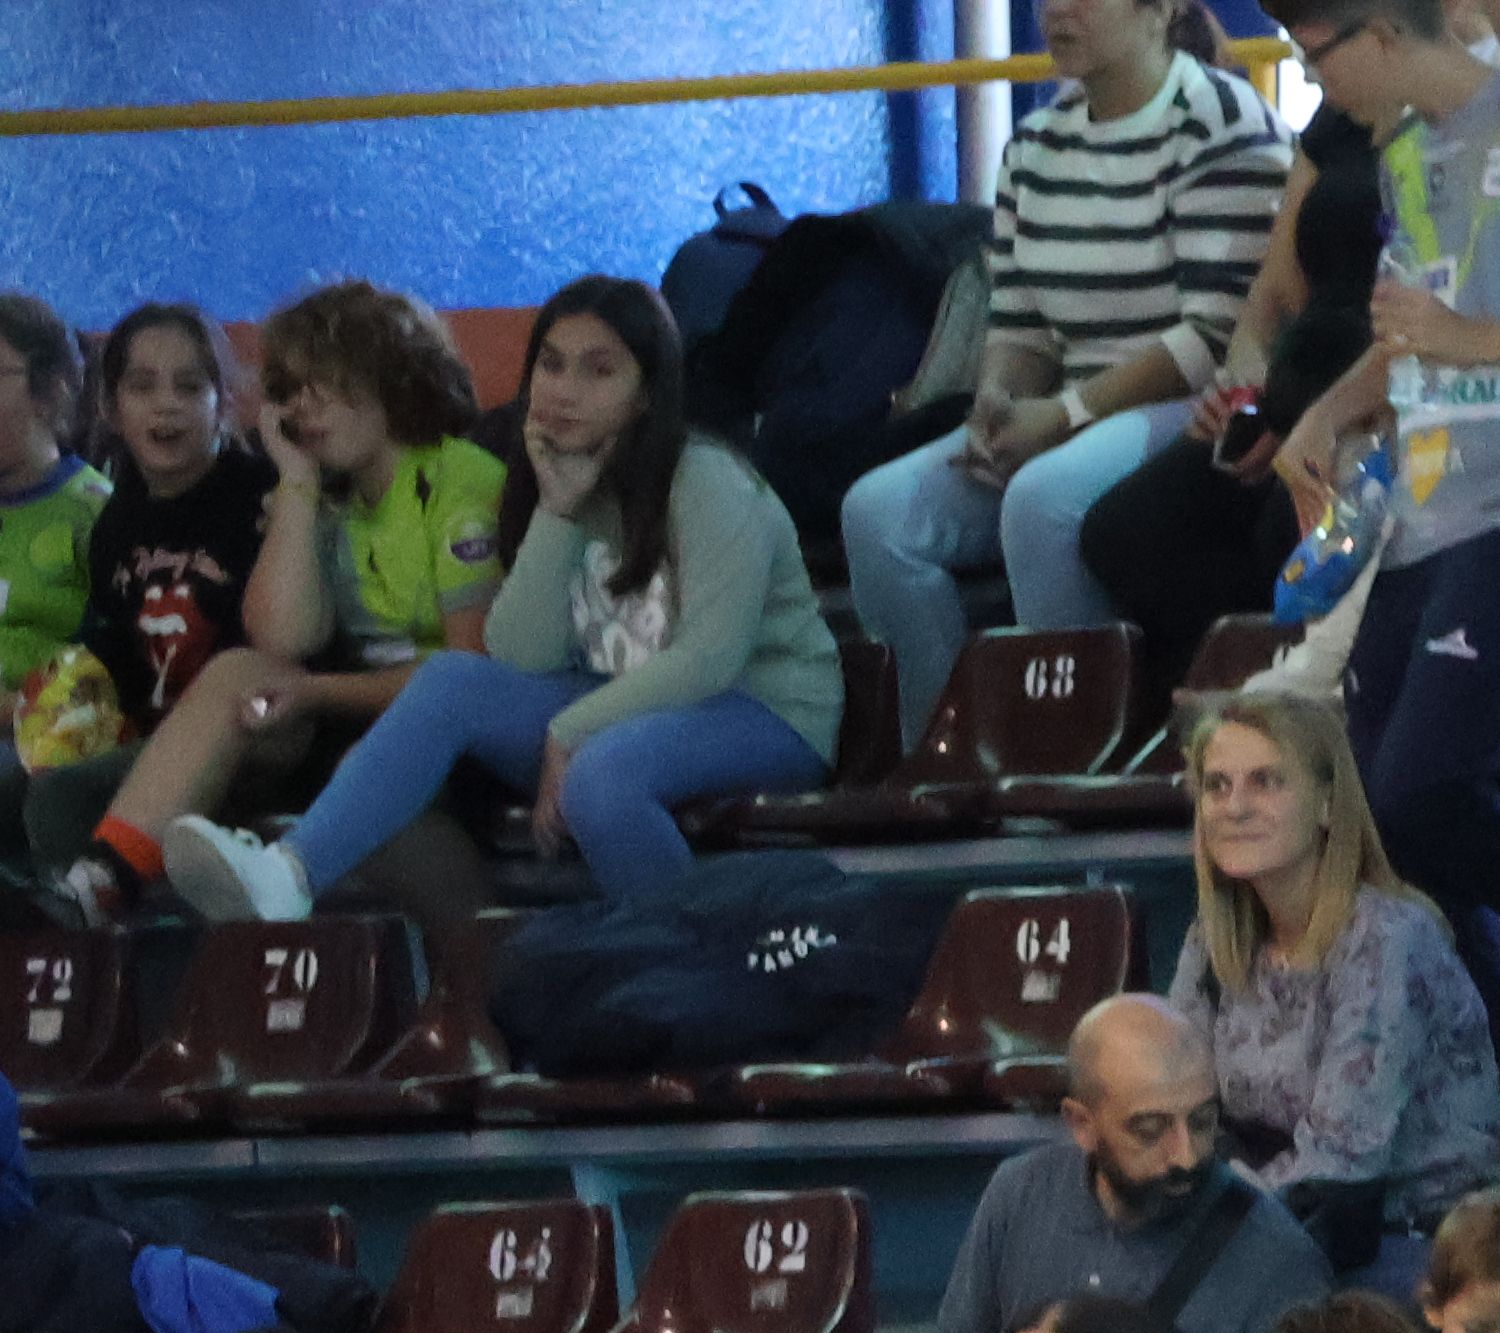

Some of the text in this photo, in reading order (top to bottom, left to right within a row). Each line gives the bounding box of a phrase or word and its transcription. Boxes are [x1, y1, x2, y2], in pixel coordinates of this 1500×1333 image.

[1024, 655, 1075, 699] 68
[1016, 918, 1071, 964] 64
[26, 959, 73, 1003] 72
[265, 949, 319, 994] 70
[744, 1220, 809, 1273] 62
